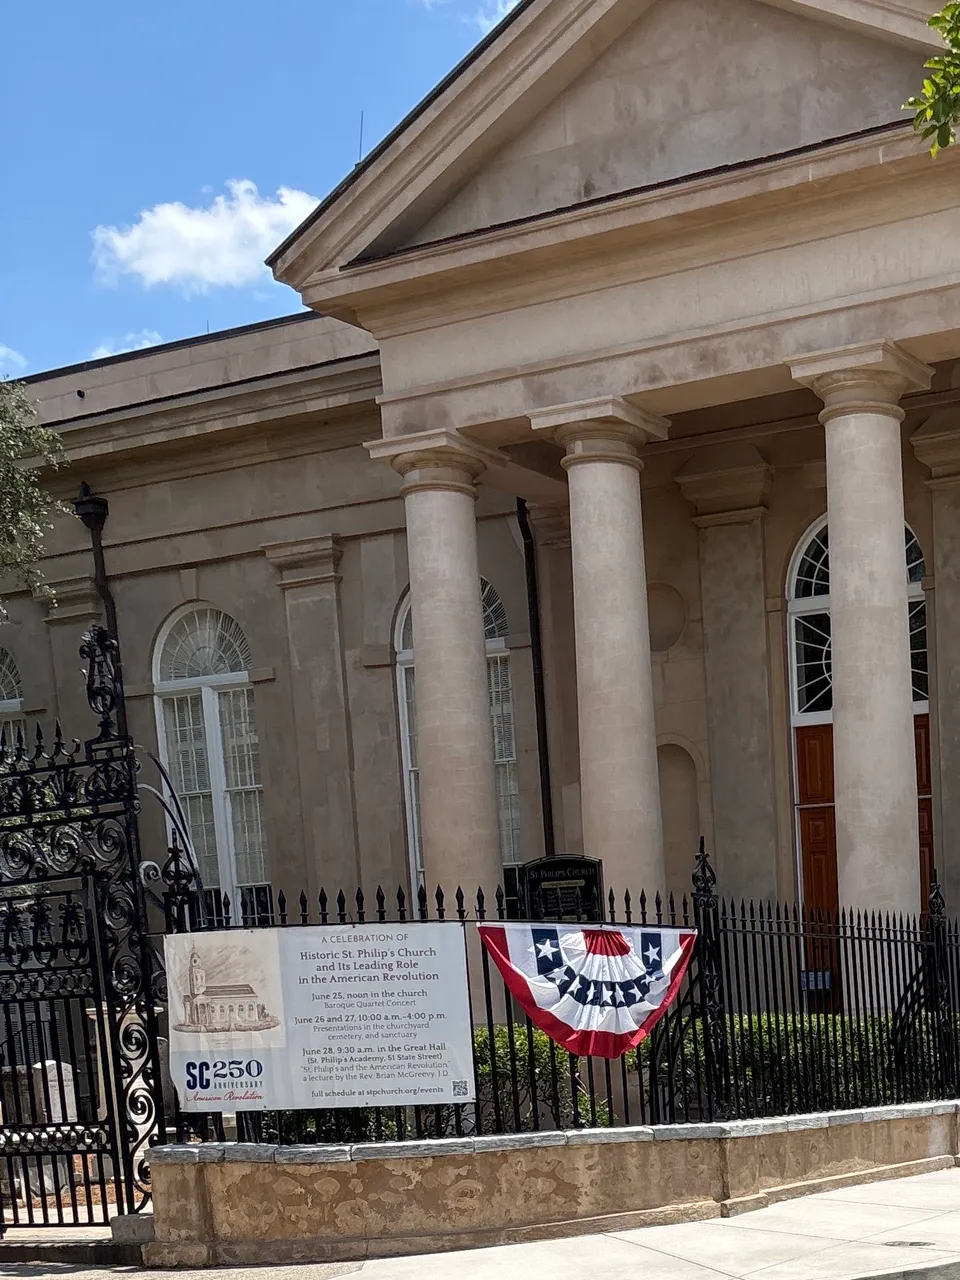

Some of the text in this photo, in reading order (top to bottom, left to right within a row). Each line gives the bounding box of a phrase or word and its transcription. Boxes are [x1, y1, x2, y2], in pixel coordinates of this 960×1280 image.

[330, 934, 394, 943] CELEBRATION
[300, 947, 437, 960] Historic St. Philip's Church
[316, 960, 419, 972] and Its Leading Role
[299, 972, 440, 984] in the American Revolution
[312, 993, 330, 1001] June
[333, 992, 345, 1000] 25,
[382, 990, 395, 998] the
[397, 989, 428, 998] church
[324, 1002, 355, 1010] Baroque
[295, 1017, 313, 1025] June
[327, 1015, 343, 1023] and
[345, 1015, 357, 1023] 27,
[314, 1025, 362, 1033] Presentations
[328, 1033, 364, 1041] cemetery,
[381, 1031, 418, 1040] sanctuary
[303, 1048, 321, 1056] June
[404, 1044, 427, 1052] Great
[429, 1043, 447, 1051] Hall
[321, 1056, 349, 1065] Philip's
[350, 1056, 386, 1064] Academy,
[340, 1064, 354, 1072] and
[356, 1063, 368, 1071] the
[369, 1062, 406, 1071] American
[308, 1074, 334, 1082] lecture
[335, 1074, 344, 1082] by
[346, 1072, 358, 1080] the
[376, 1071, 396, 1079] Brian
[214, 1081, 263, 1090] ANNIVERSARY
[187, 1091, 264, 1102] American Revolution
[325, 1089, 357, 1097] schedule
[366, 1086, 444, 1097] stpchurch.org/events
